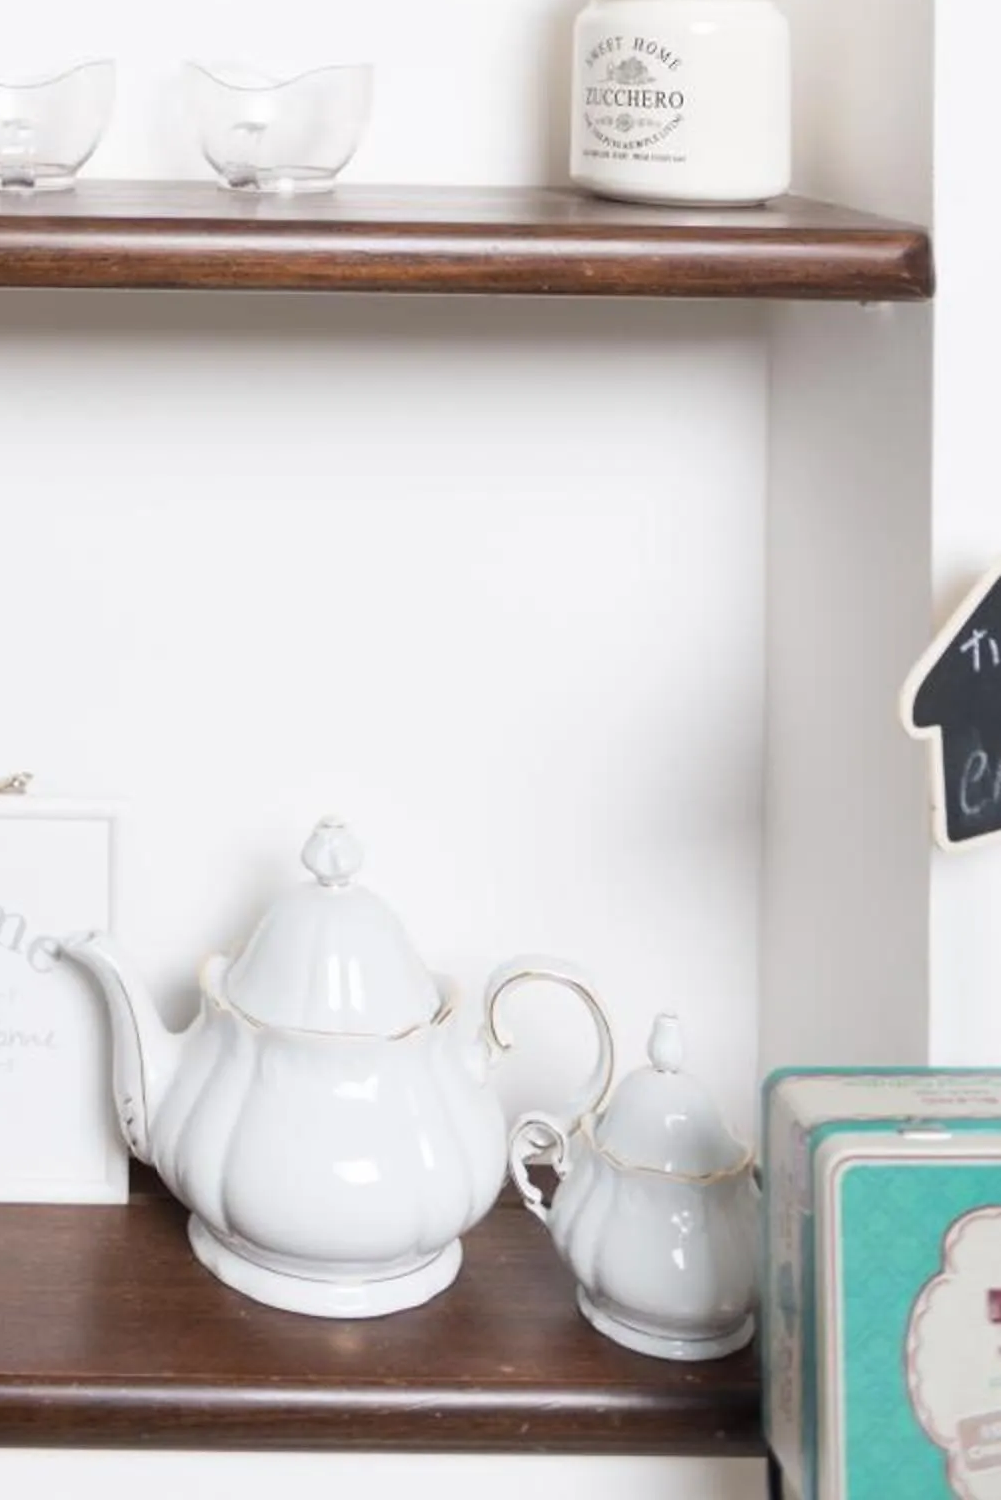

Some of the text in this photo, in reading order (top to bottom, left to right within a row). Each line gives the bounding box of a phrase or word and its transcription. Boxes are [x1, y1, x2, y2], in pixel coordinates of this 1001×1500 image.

[585, 36, 681, 70] SWEET HOME
[585, 87, 684, 108] ZUCCHERO
